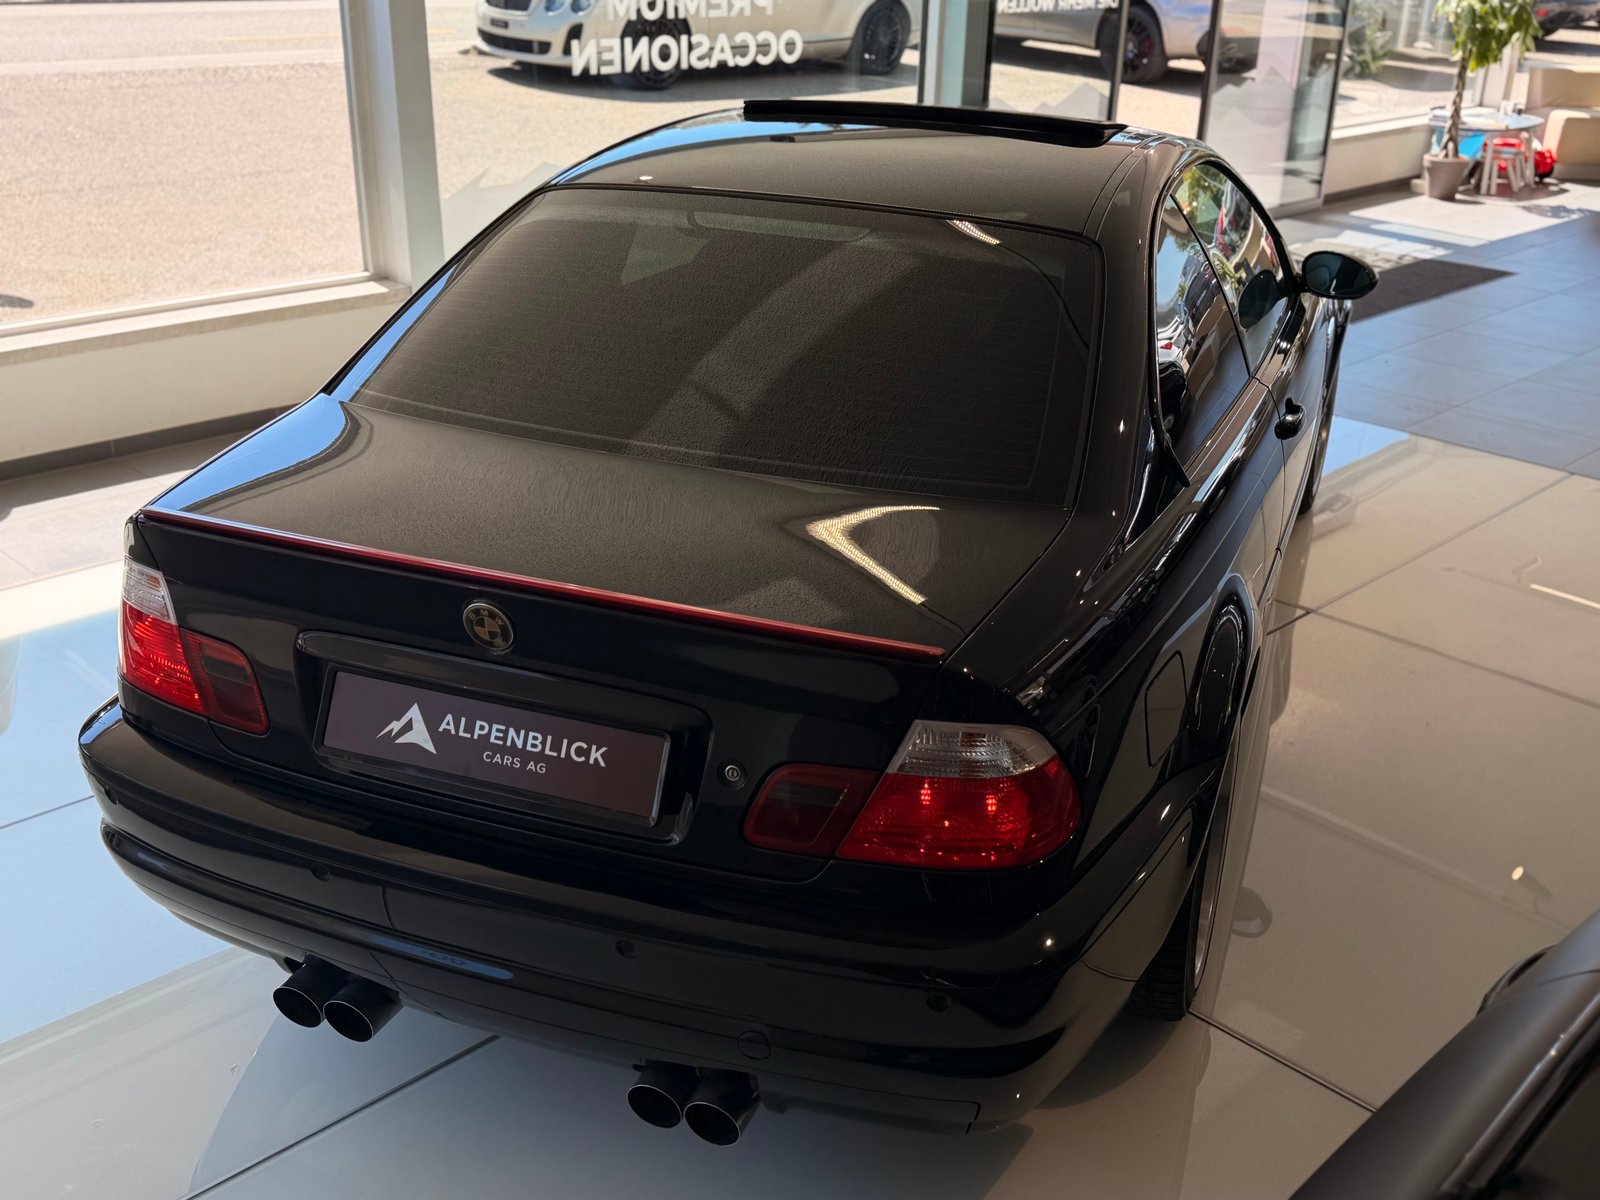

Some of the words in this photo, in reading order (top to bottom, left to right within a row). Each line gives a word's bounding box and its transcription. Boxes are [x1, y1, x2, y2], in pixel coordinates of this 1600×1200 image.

[438, 713, 608, 767] ALPENBLICK
[483, 751, 522, 769] CARS
[525, 761, 548, 774] AG
